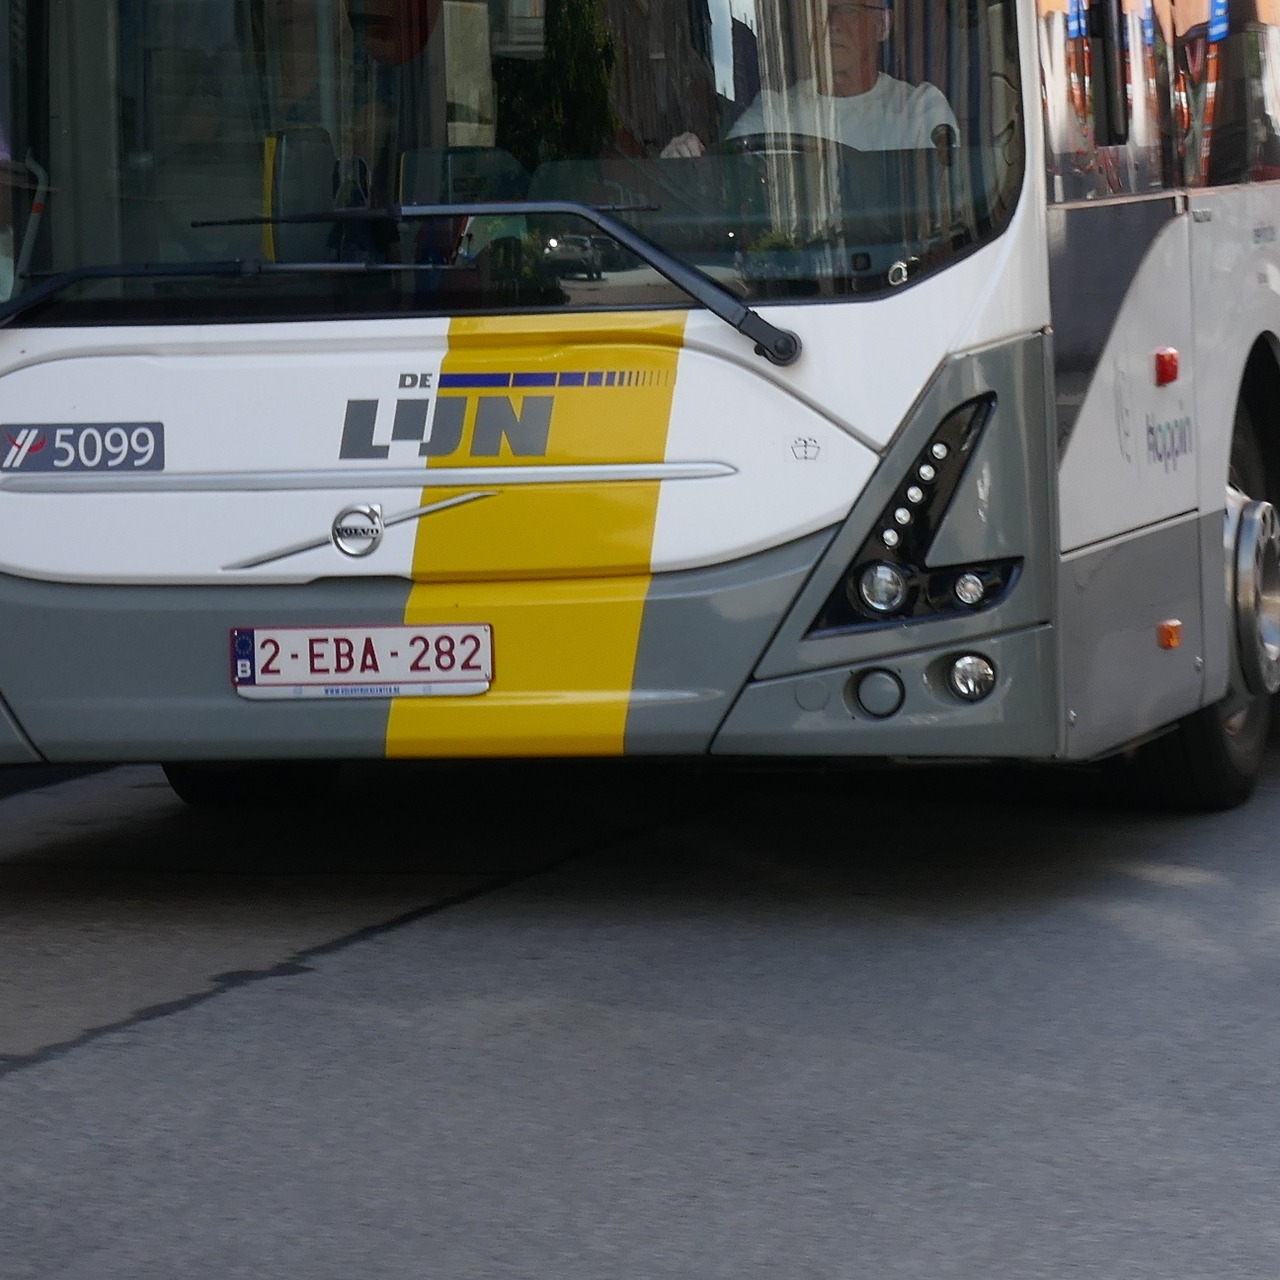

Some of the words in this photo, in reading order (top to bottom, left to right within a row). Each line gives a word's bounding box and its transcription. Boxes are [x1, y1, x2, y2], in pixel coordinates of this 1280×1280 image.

[398, 373, 433, 389] DE
[53, 426, 155, 468] 5099
[1145, 399, 1193, 474] Hoppin
[335, 527, 380, 538] VOLVO
[237, 659, 251, 679] B
[259, 634, 482, 675] 2-EBA-282
